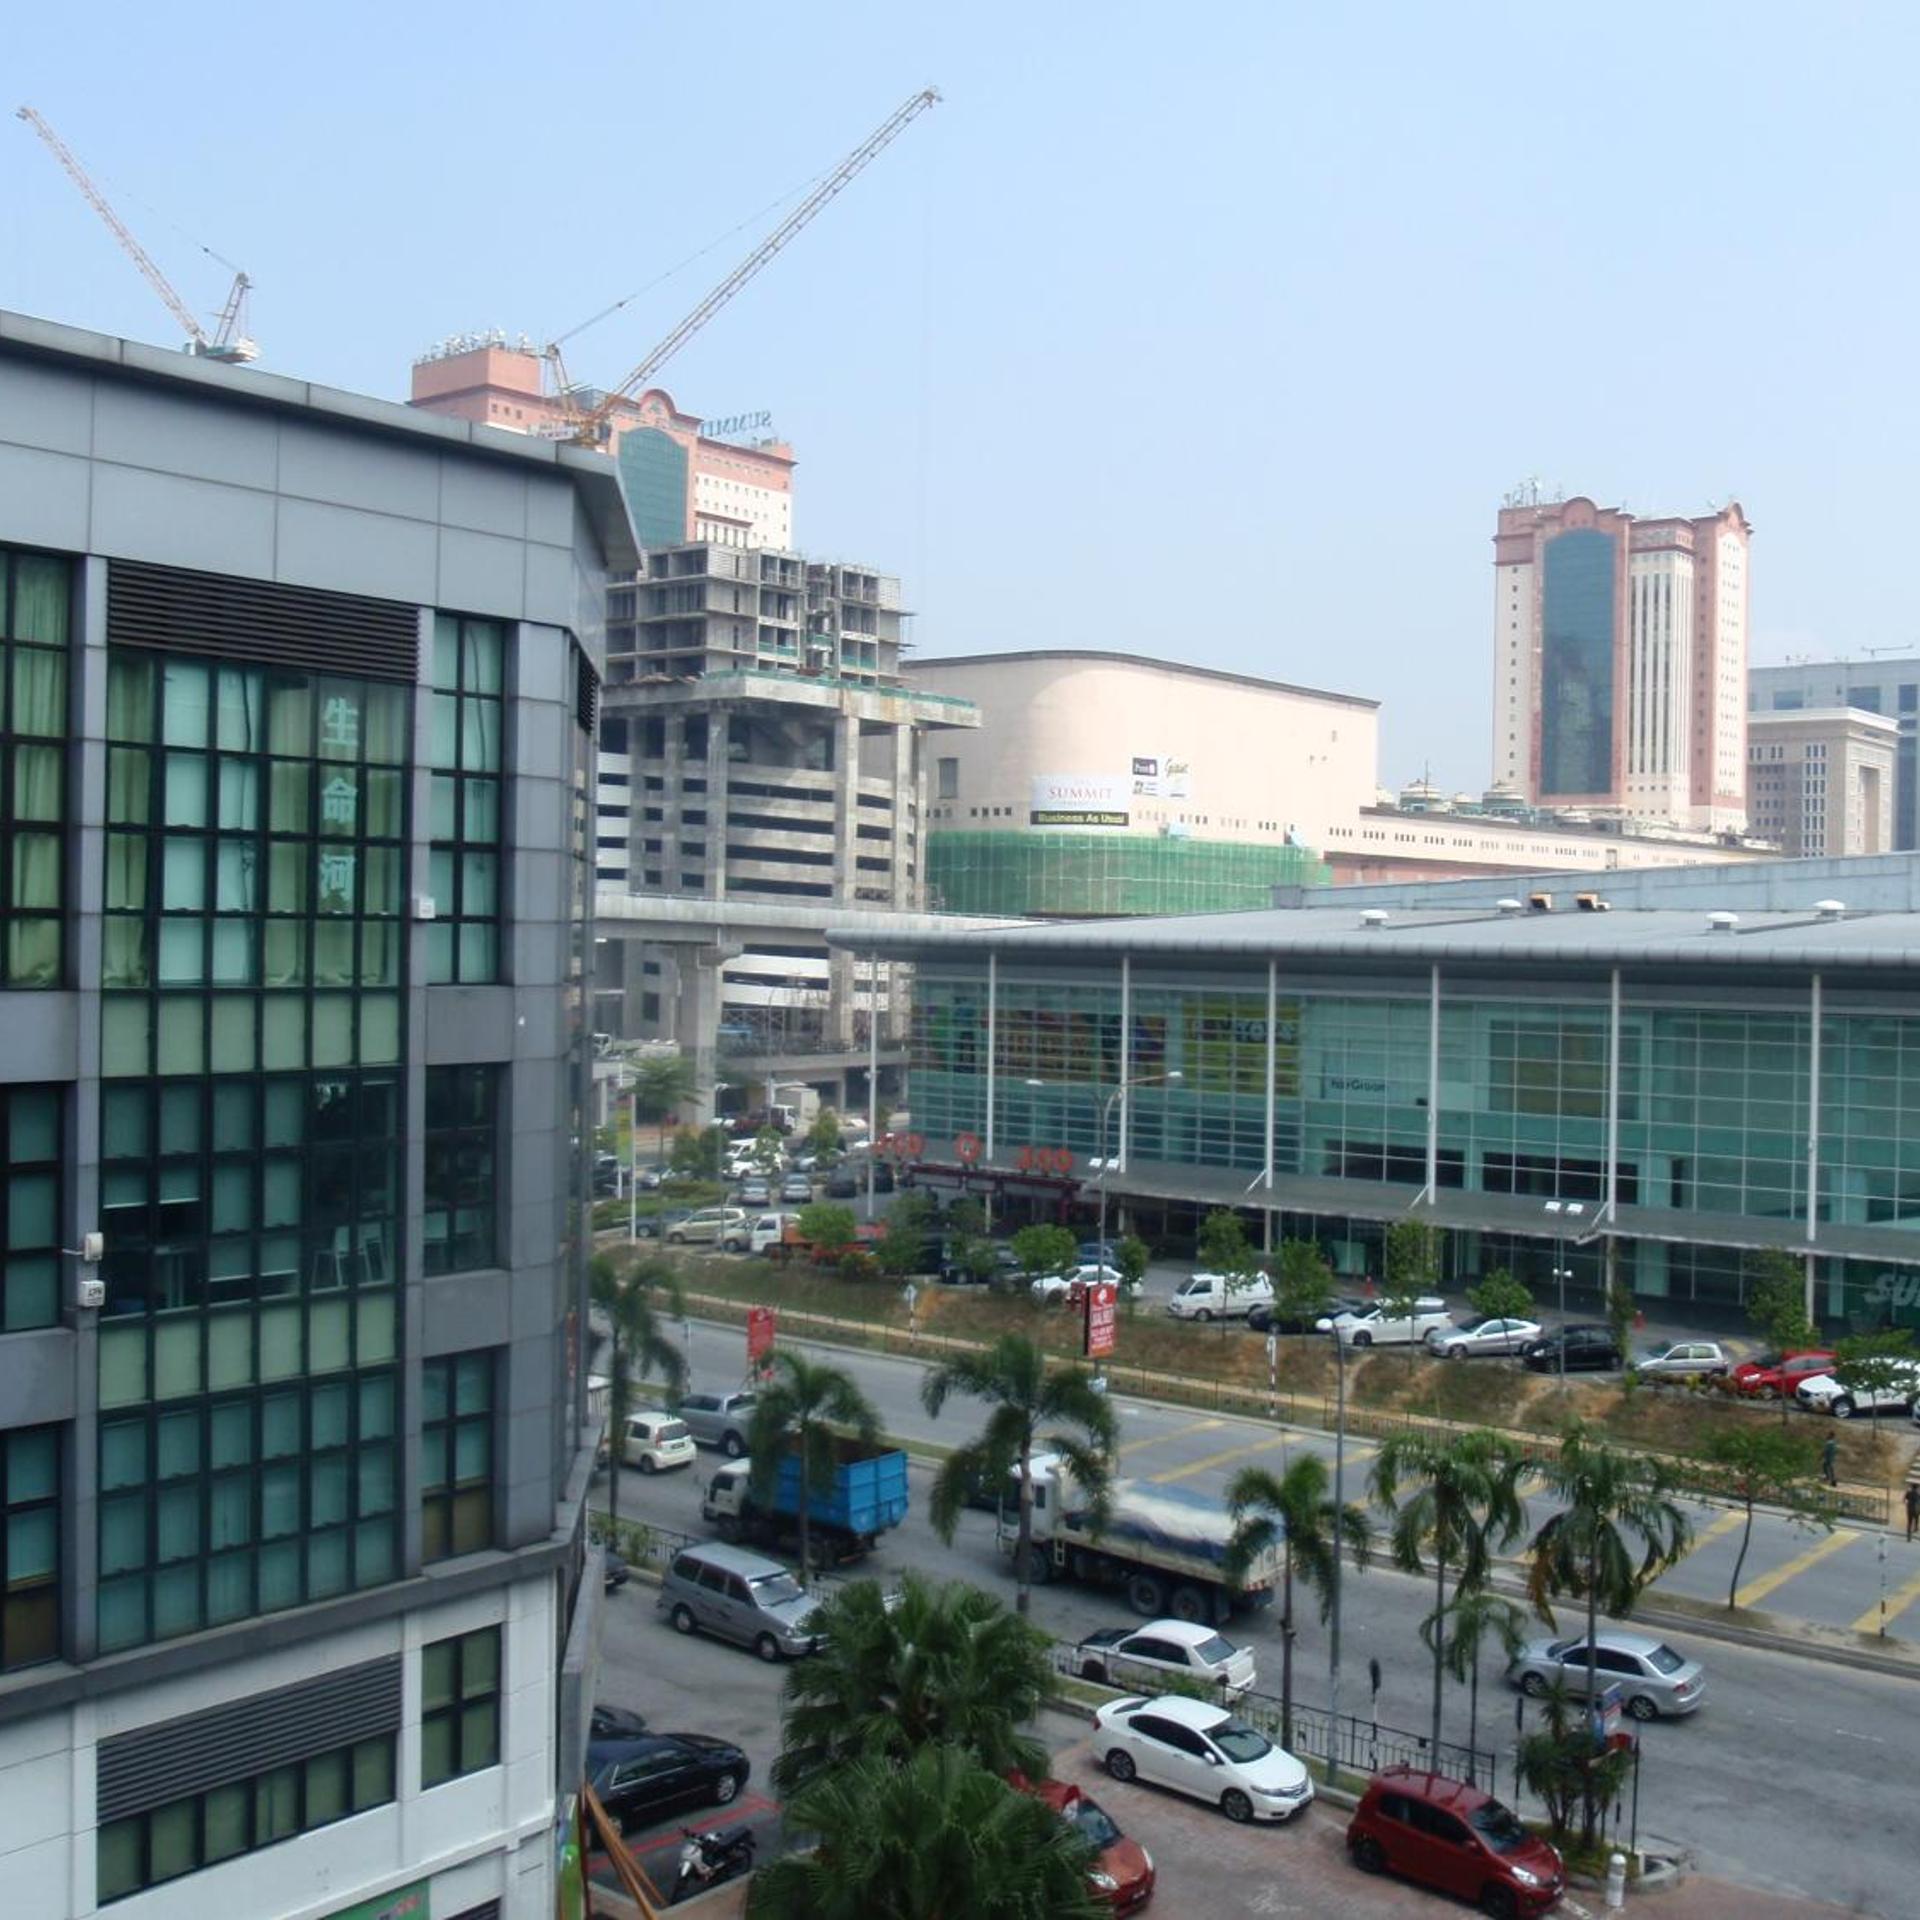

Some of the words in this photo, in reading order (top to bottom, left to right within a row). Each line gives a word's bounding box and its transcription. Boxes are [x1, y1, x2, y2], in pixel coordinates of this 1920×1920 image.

[1049, 787, 1112, 799] SUMMIT
[1039, 812, 1083, 822] Business
[1086, 813, 1099, 823] As
[1101, 813, 1125, 824] Usual
